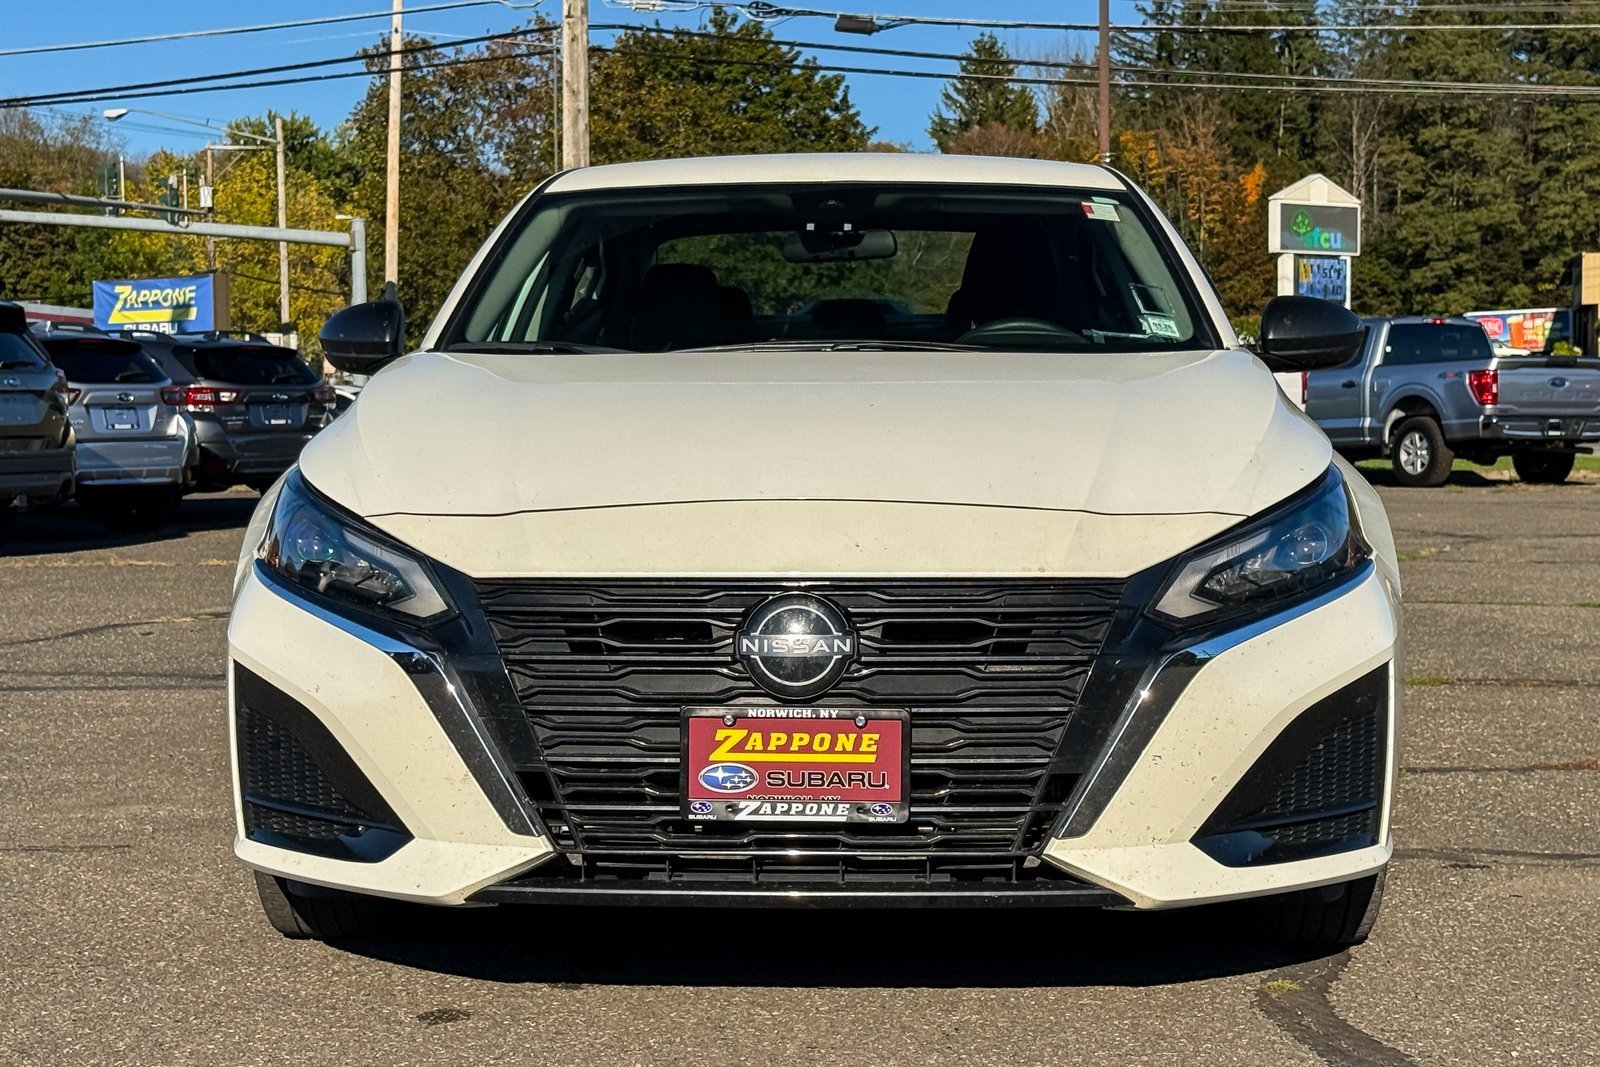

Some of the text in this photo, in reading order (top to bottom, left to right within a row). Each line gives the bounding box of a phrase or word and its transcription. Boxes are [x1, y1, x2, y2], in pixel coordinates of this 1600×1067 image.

[108, 285, 197, 325] ZAPPONE
[741, 637, 852, 654] NISSAN
[747, 708, 840, 719] NORWICH, NY
[708, 729, 880, 763] ZAPPONE
[765, 770, 888, 789] SUBARU
[734, 801, 850, 822] ZAPPONE
